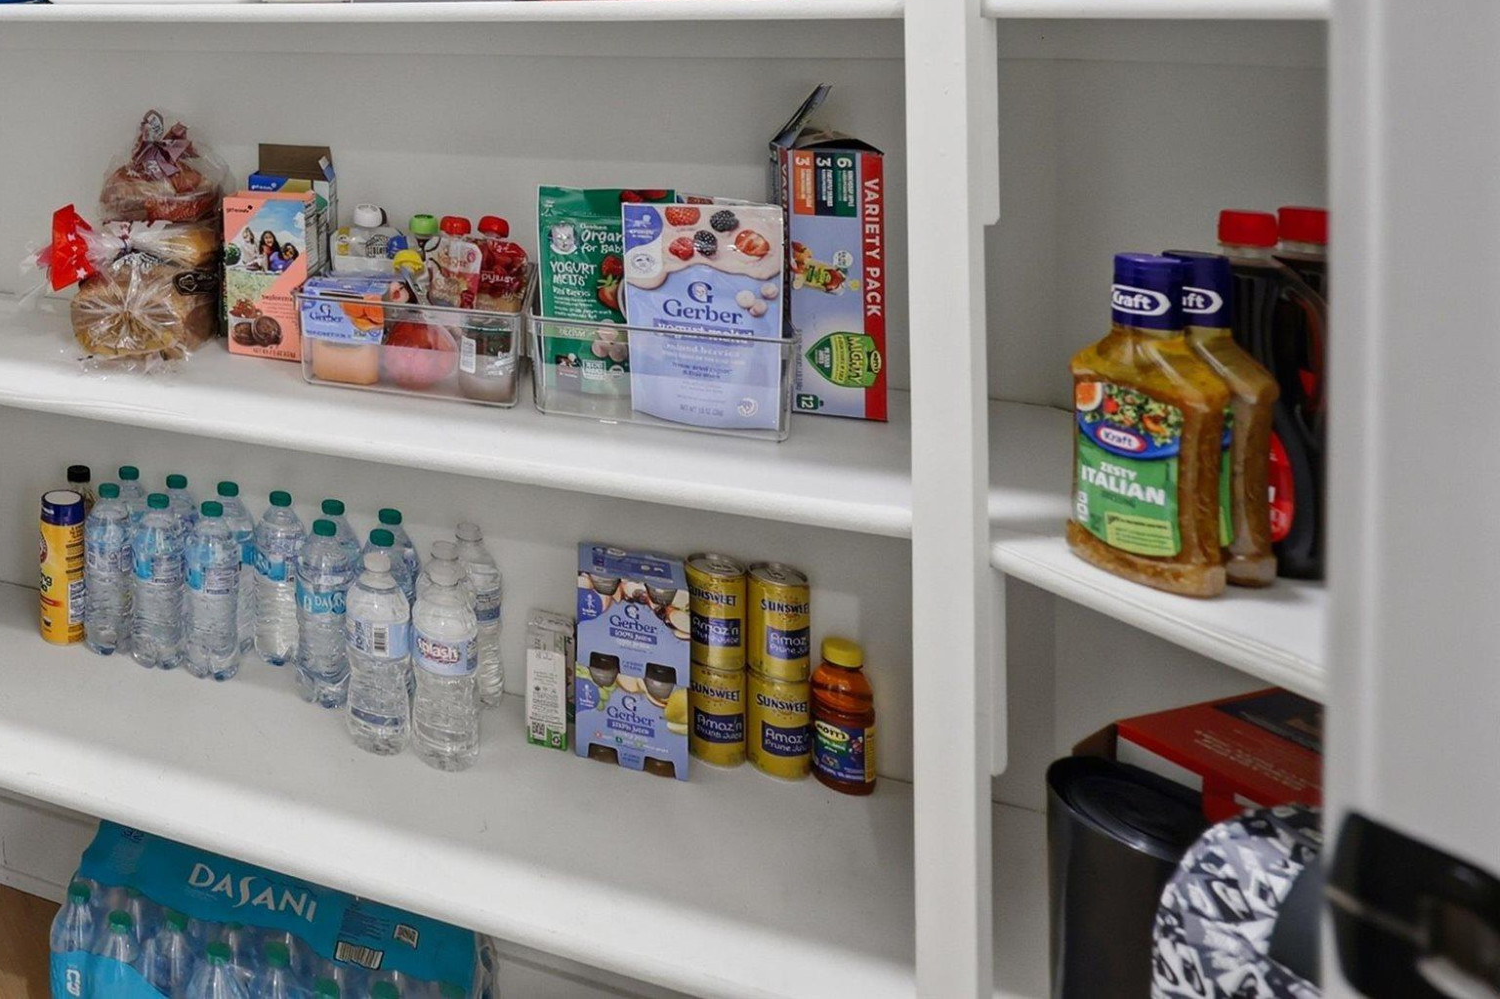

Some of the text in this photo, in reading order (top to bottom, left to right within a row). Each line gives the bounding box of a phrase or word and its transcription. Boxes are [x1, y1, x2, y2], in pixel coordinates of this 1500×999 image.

[796, 157, 810, 166] 3
[816, 157, 832, 166] 3
[837, 157, 852, 168] 6
[864, 178, 881, 317] VARIETY PACK
[550, 261, 595, 275] YOGURT
[663, 299, 743, 324] Gerber
[848, 336, 863, 385] MIGHTY
[801, 395, 814, 408] 12
[1103, 429, 1133, 446] Kraft
[1100, 461, 1137, 480] ZESTY
[1081, 465, 1165, 506] ITALIAN
[610, 614, 657, 634] Gerber
[607, 706, 655, 727] Gerber
[187, 862, 318, 924] DASANI
